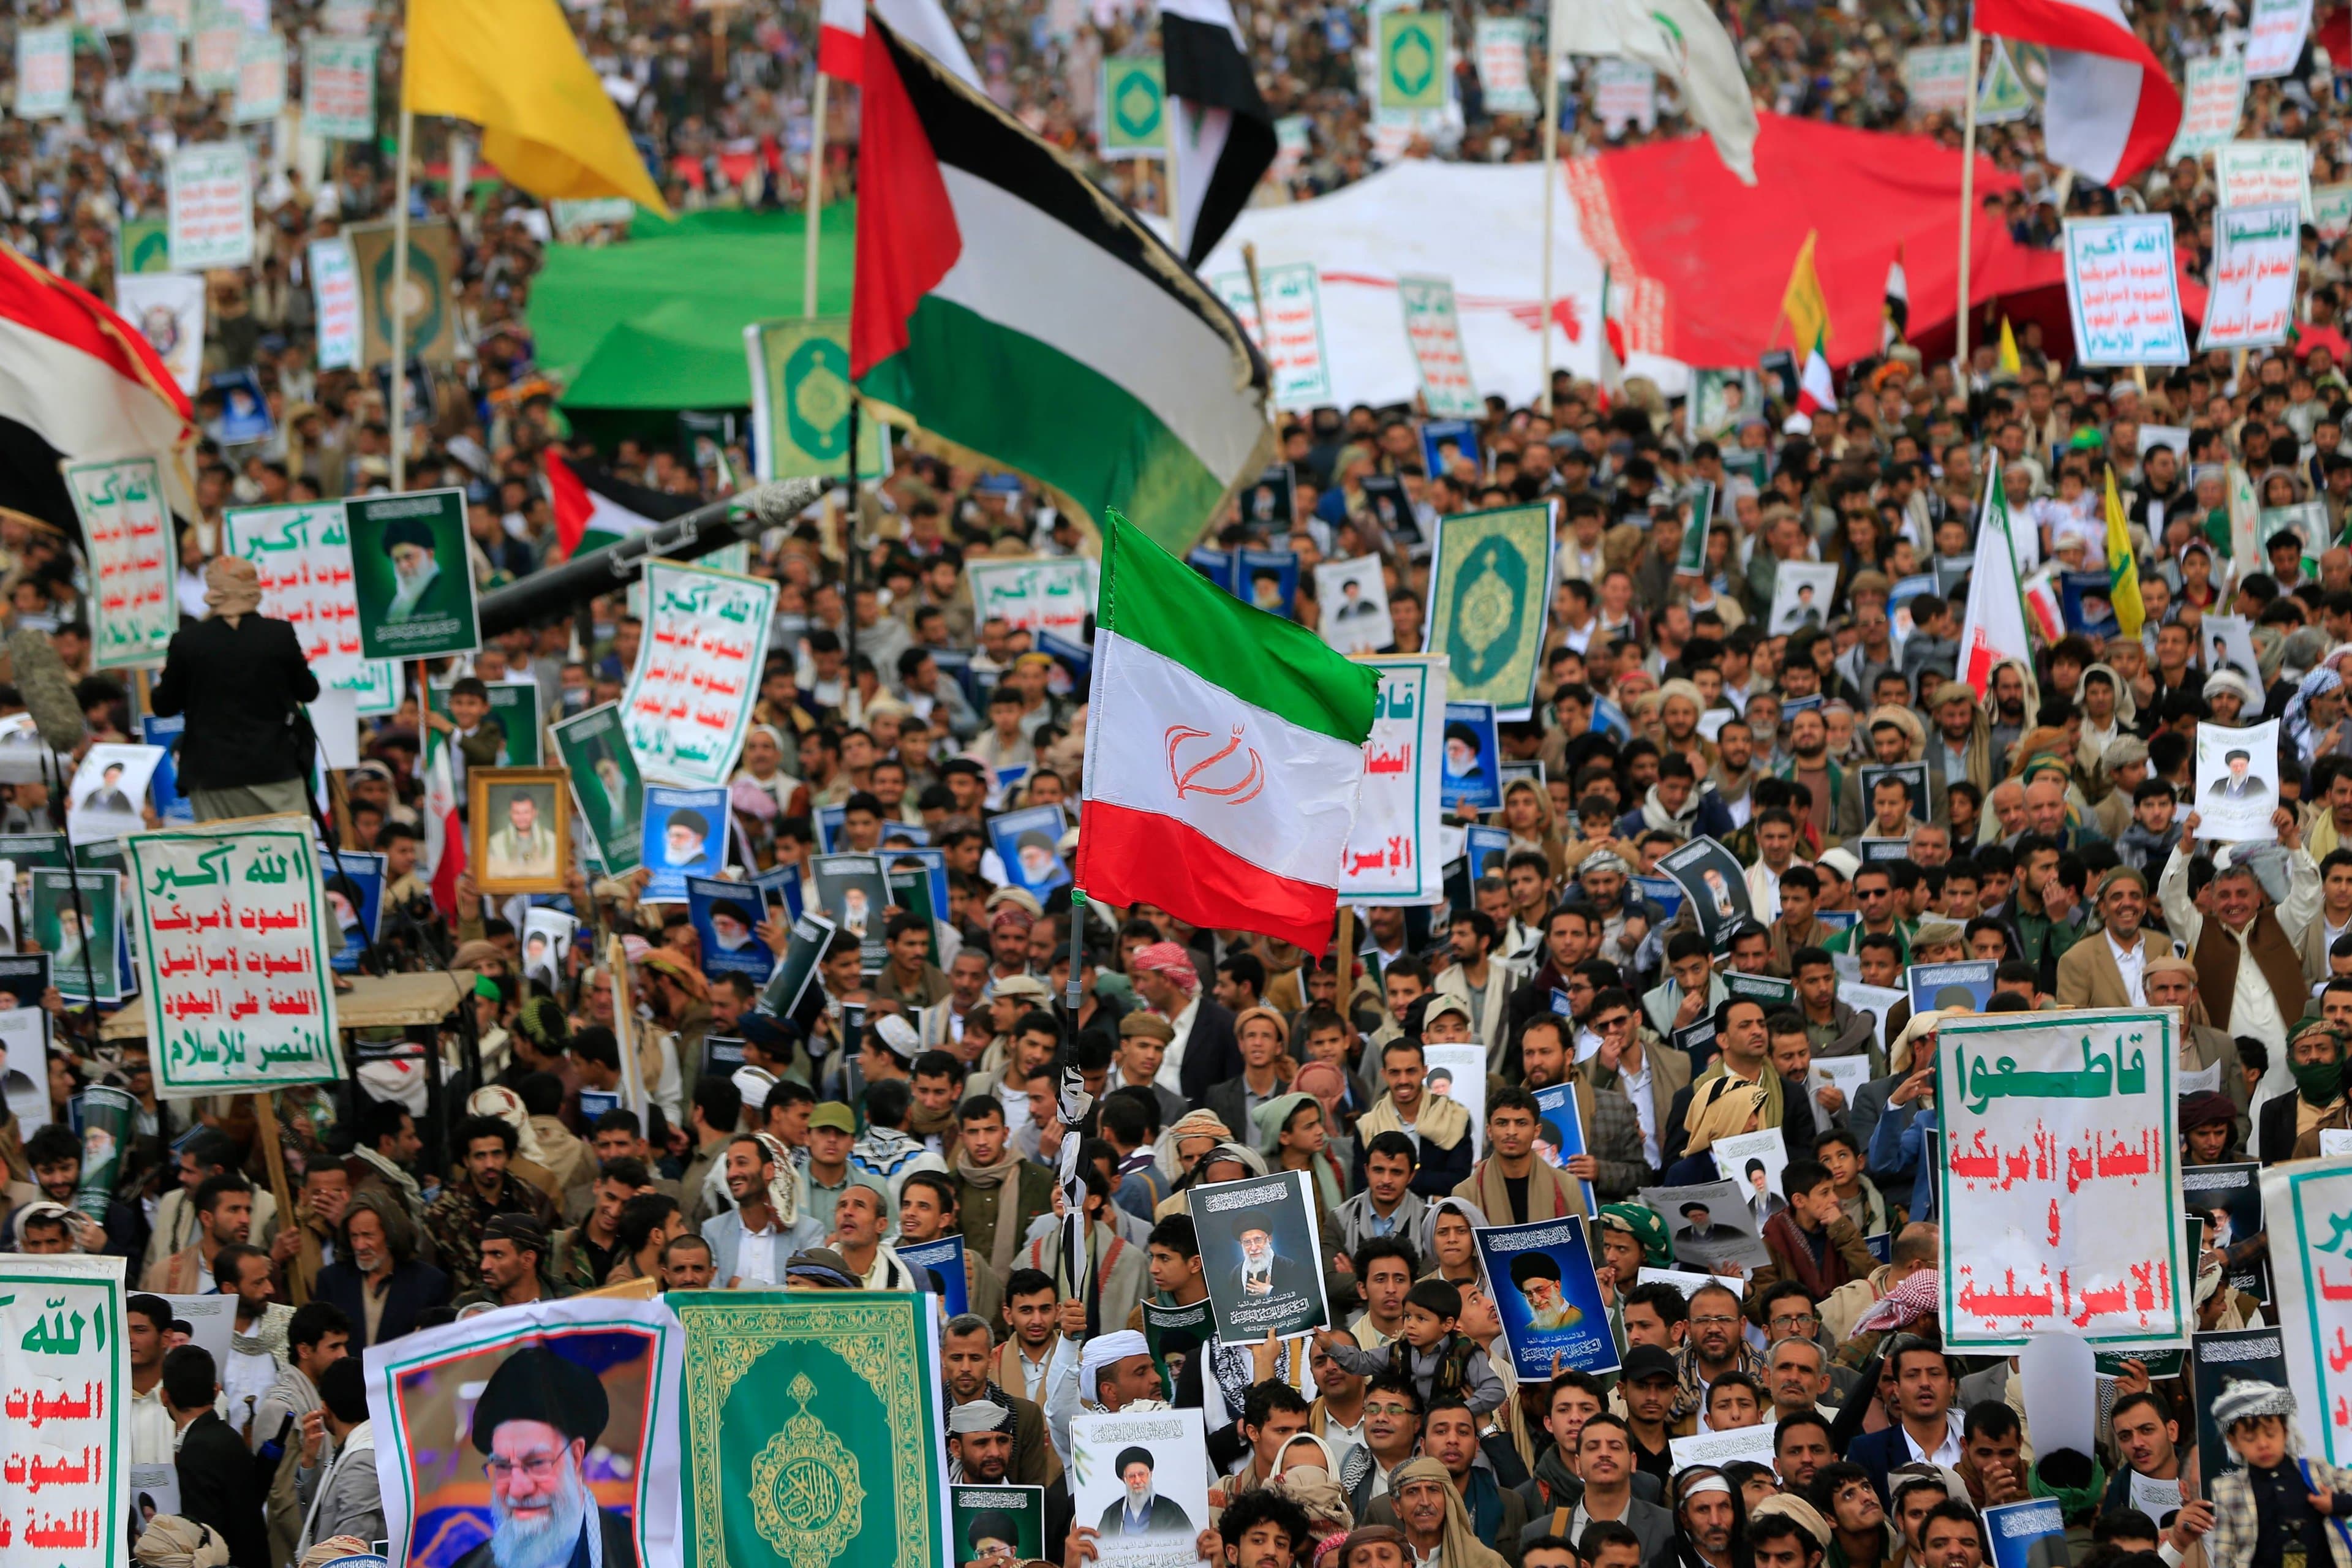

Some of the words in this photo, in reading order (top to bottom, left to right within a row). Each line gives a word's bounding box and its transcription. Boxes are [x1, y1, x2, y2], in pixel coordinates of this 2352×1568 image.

[146, 839, 237, 902] أكبر
[245, 843, 304, 884] الله
[1343, 837, 1412, 877] الإسرا
[151, 897, 233, 934] لأمريكا
[240, 902, 307, 935] الموت
[160, 944, 239, 979] لإسرائيل
[246, 947, 311, 978] الموت
[165, 989, 222, 1021] اليهود
[268, 988, 318, 1016] اللعنة
[171, 1027, 246, 1076] للإسلام
[257, 1025, 324, 1073] النصر
[1953, 1031, 2147, 1115] قاطعوا
[1949, 1117, 2057, 1191] الأمريكية
[2067, 1126, 2161, 1194] البضائع
[2046, 1198, 2062, 1248] و
[1957, 1257, 2172, 1330] الإسرائيلية
[21, 1296, 107, 1355] الله
[5, 1380, 104, 1429] الموت
[4, 1444, 102, 1494] الموت
[25, 1506, 99, 1549] اللعنة
